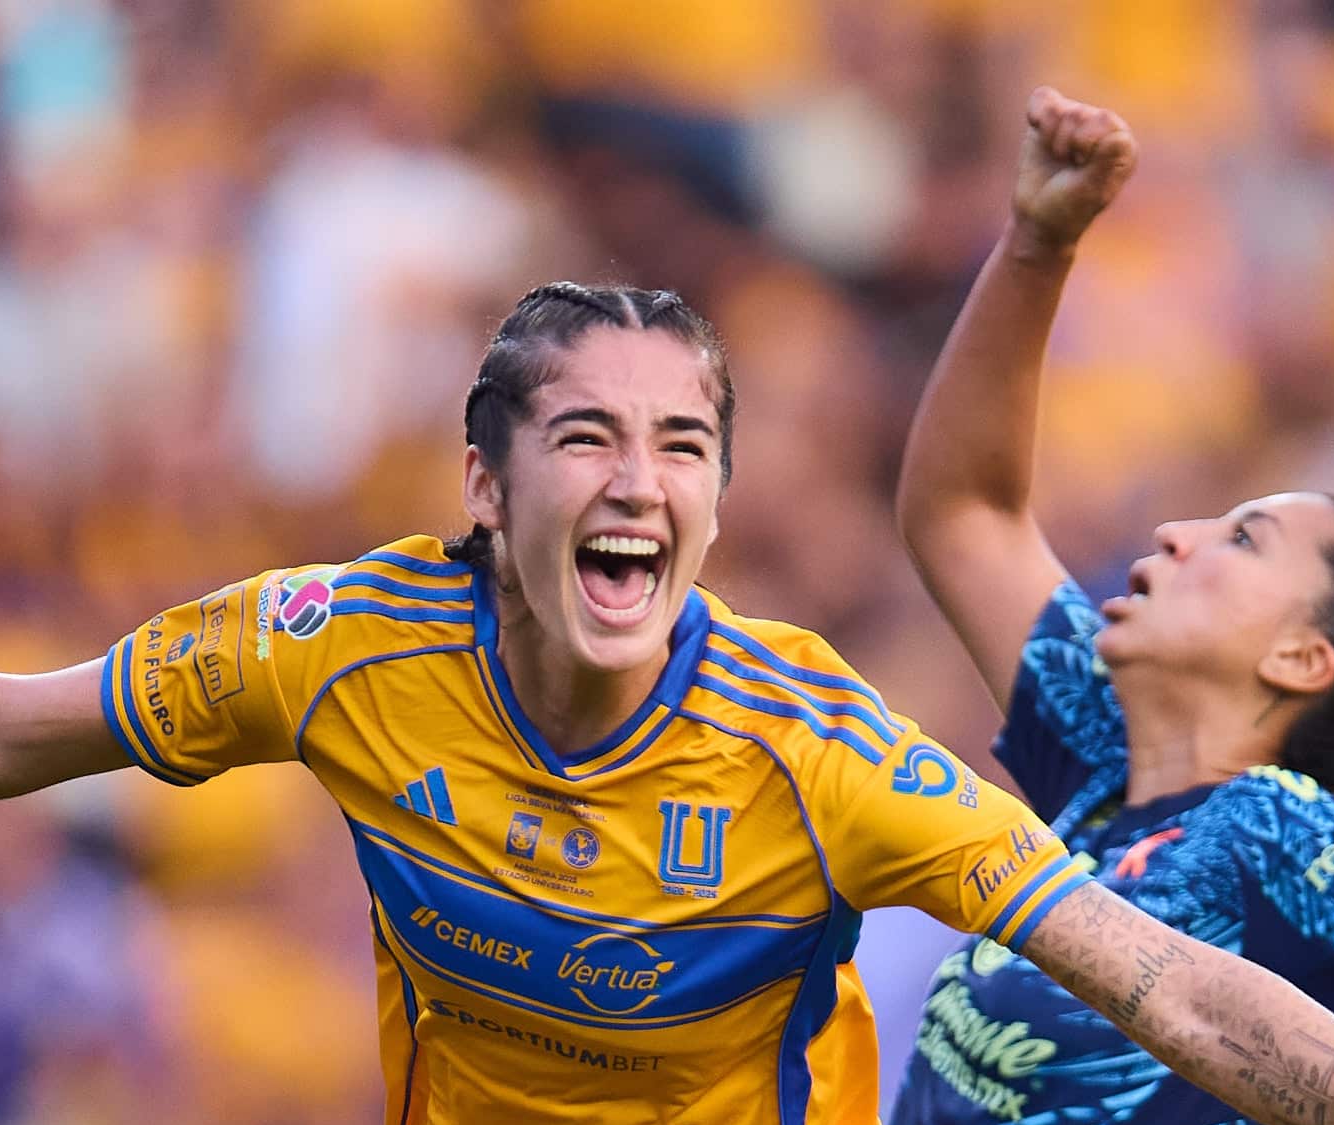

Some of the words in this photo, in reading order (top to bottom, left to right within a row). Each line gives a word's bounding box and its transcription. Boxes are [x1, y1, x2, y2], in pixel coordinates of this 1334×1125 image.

[203, 597, 227, 692] Ternium
[144, 657, 174, 737] FUTURO
[493, 867, 530, 882] ESTADIO
[963, 856, 1017, 902] Tim
[434, 920, 533, 970] CEMEX
[557, 952, 660, 990] Vertua
